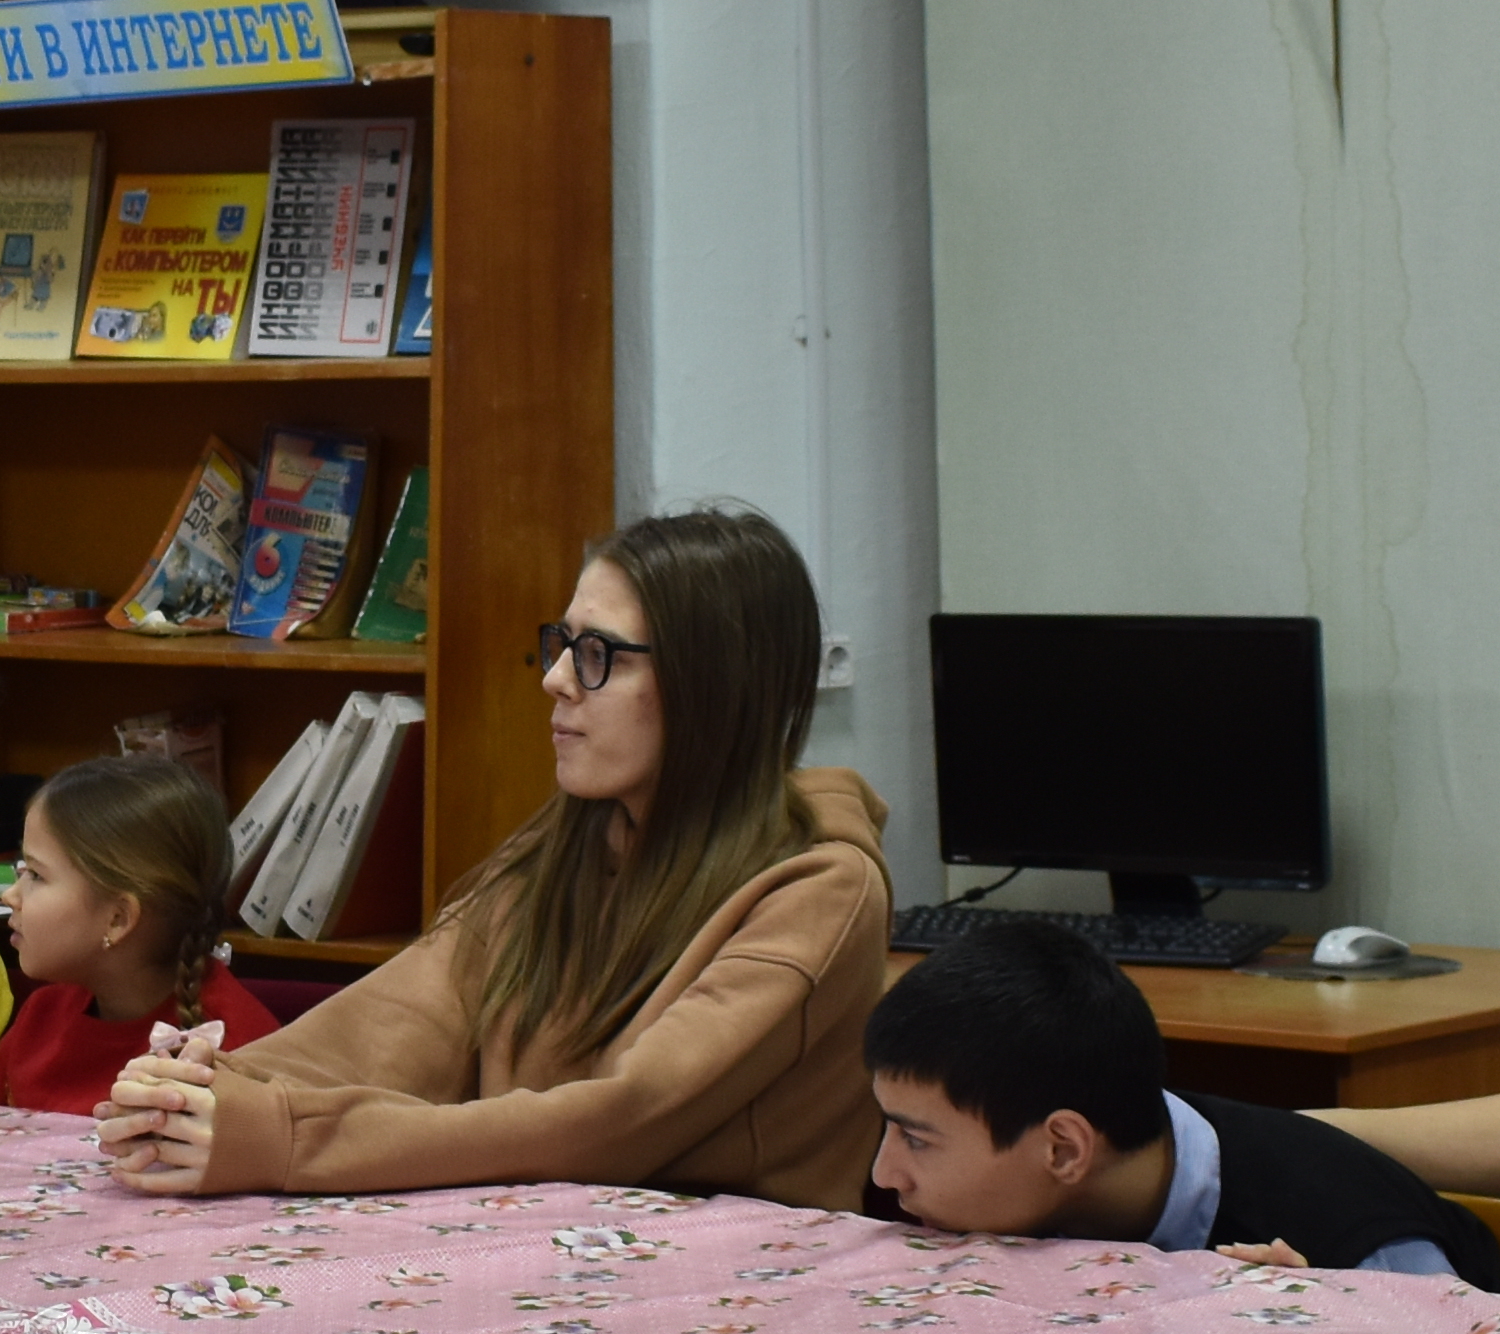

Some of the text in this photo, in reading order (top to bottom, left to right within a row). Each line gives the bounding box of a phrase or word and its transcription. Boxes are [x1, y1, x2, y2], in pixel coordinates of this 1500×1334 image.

[35, 21, 70, 79] В
[71, 0, 324, 76] ИНТЕРНЕТЕ
[121, 225, 207, 245] КАК ПЕРЕЙТИ
[331, 185, 353, 272] УЧЕБНИК
[115, 250, 249, 273] КОМПЬЮТЕРОМ
[171, 279, 194, 296] НА
[198, 278, 242, 315] ТЫ
